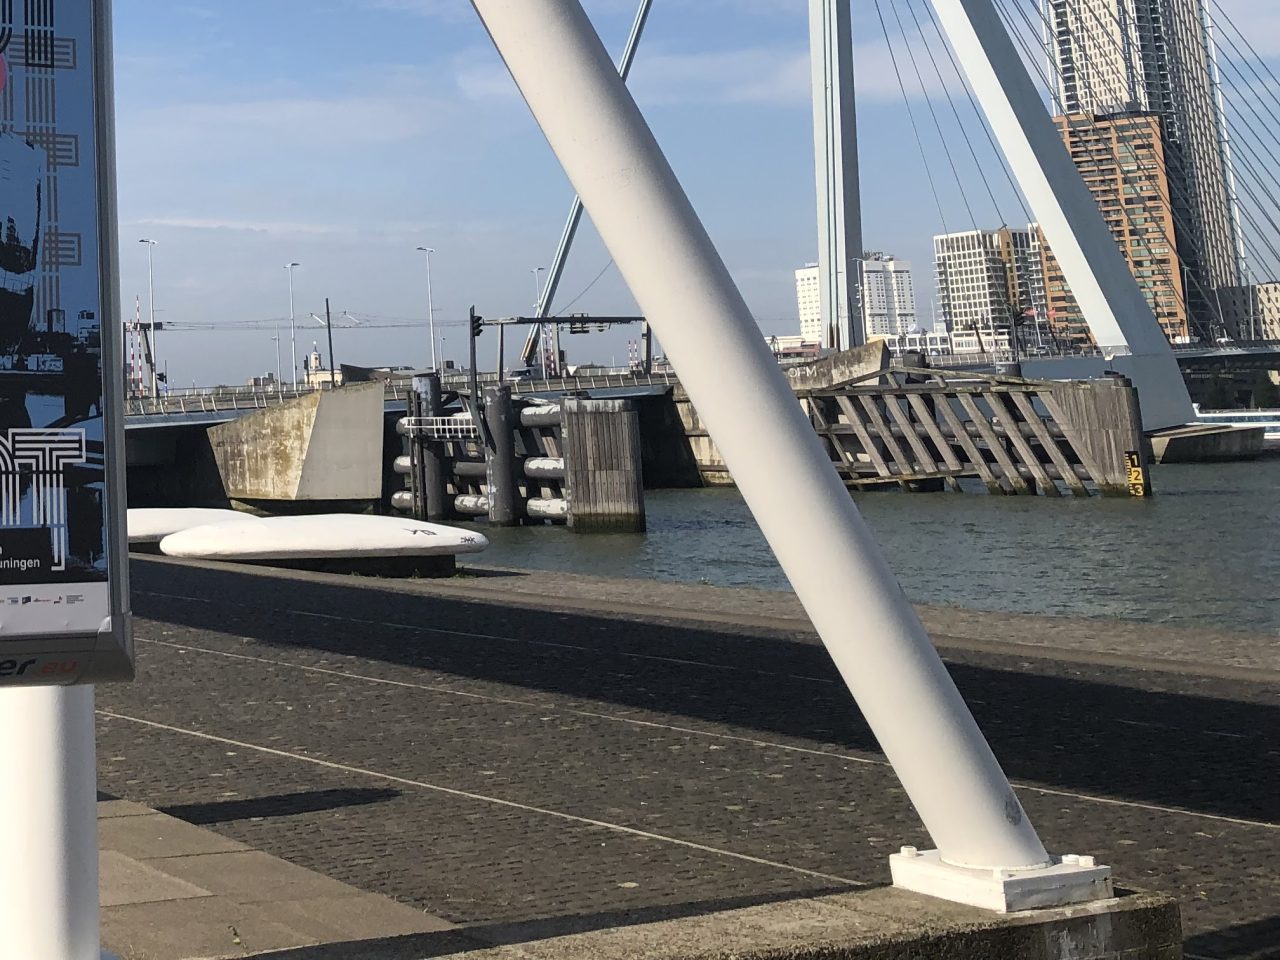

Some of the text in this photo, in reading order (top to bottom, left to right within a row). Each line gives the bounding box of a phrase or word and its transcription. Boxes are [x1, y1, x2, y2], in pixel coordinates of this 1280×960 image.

[1131, 454, 1138, 466] 1
[1132, 470, 1141, 481] 2
[1135, 484, 1144, 496] 3
